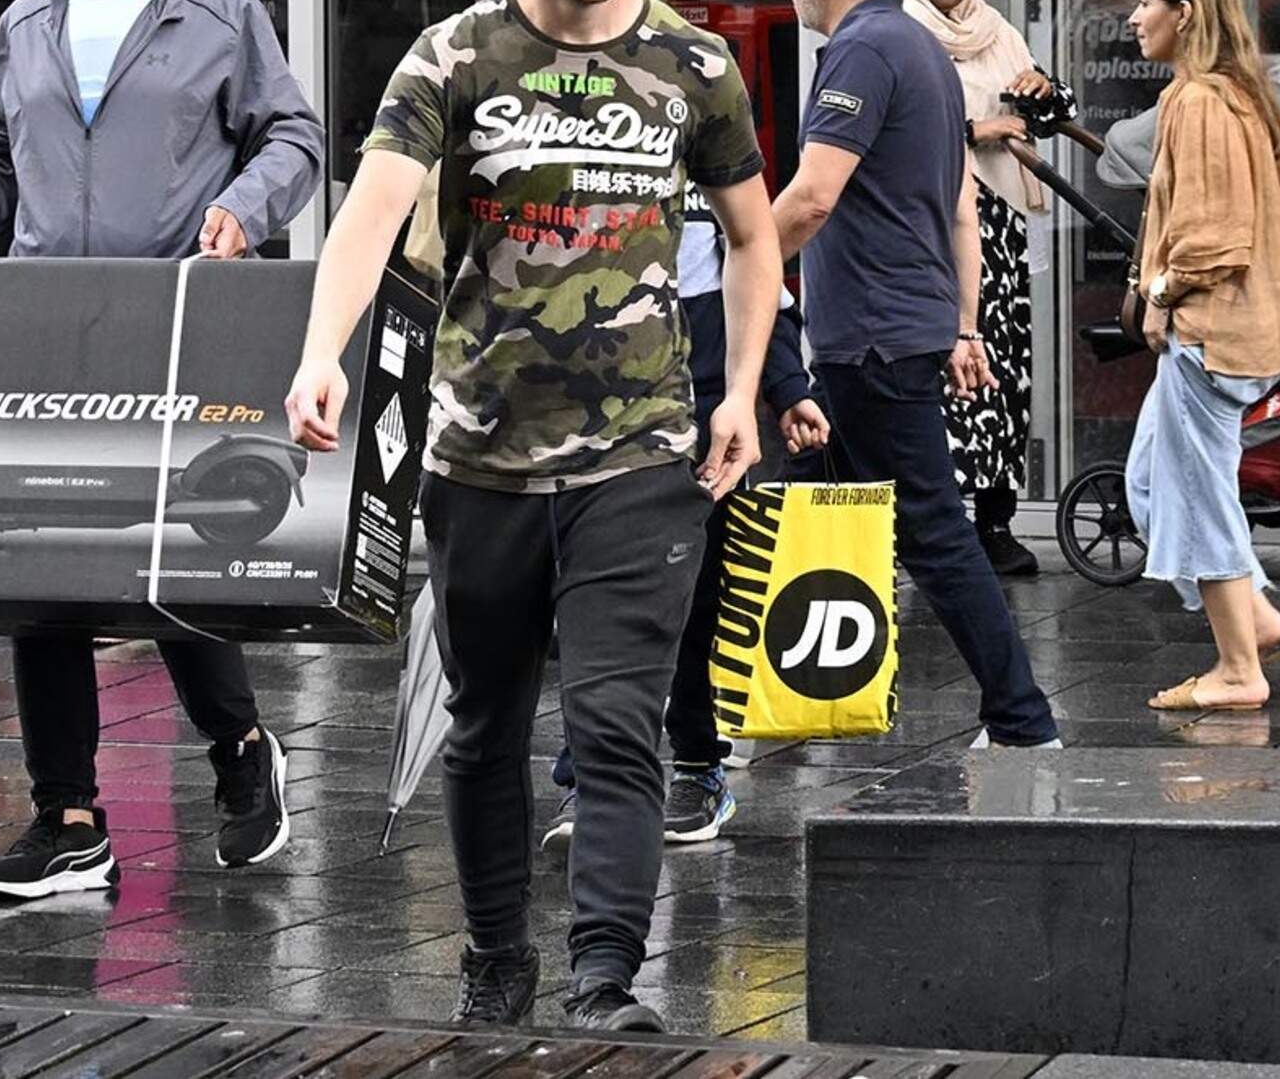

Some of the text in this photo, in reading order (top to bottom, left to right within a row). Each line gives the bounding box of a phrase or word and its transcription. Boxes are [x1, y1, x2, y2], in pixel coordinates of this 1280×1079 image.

[1084, 57, 1175, 84] oplossin
[523, 72, 616, 97] VINTAGE
[199, 404, 226, 423] E2
[228, 405, 265, 423] Pro
[811, 488, 891, 506] FOREVER FORWARD
[781, 600, 876, 669] JD
